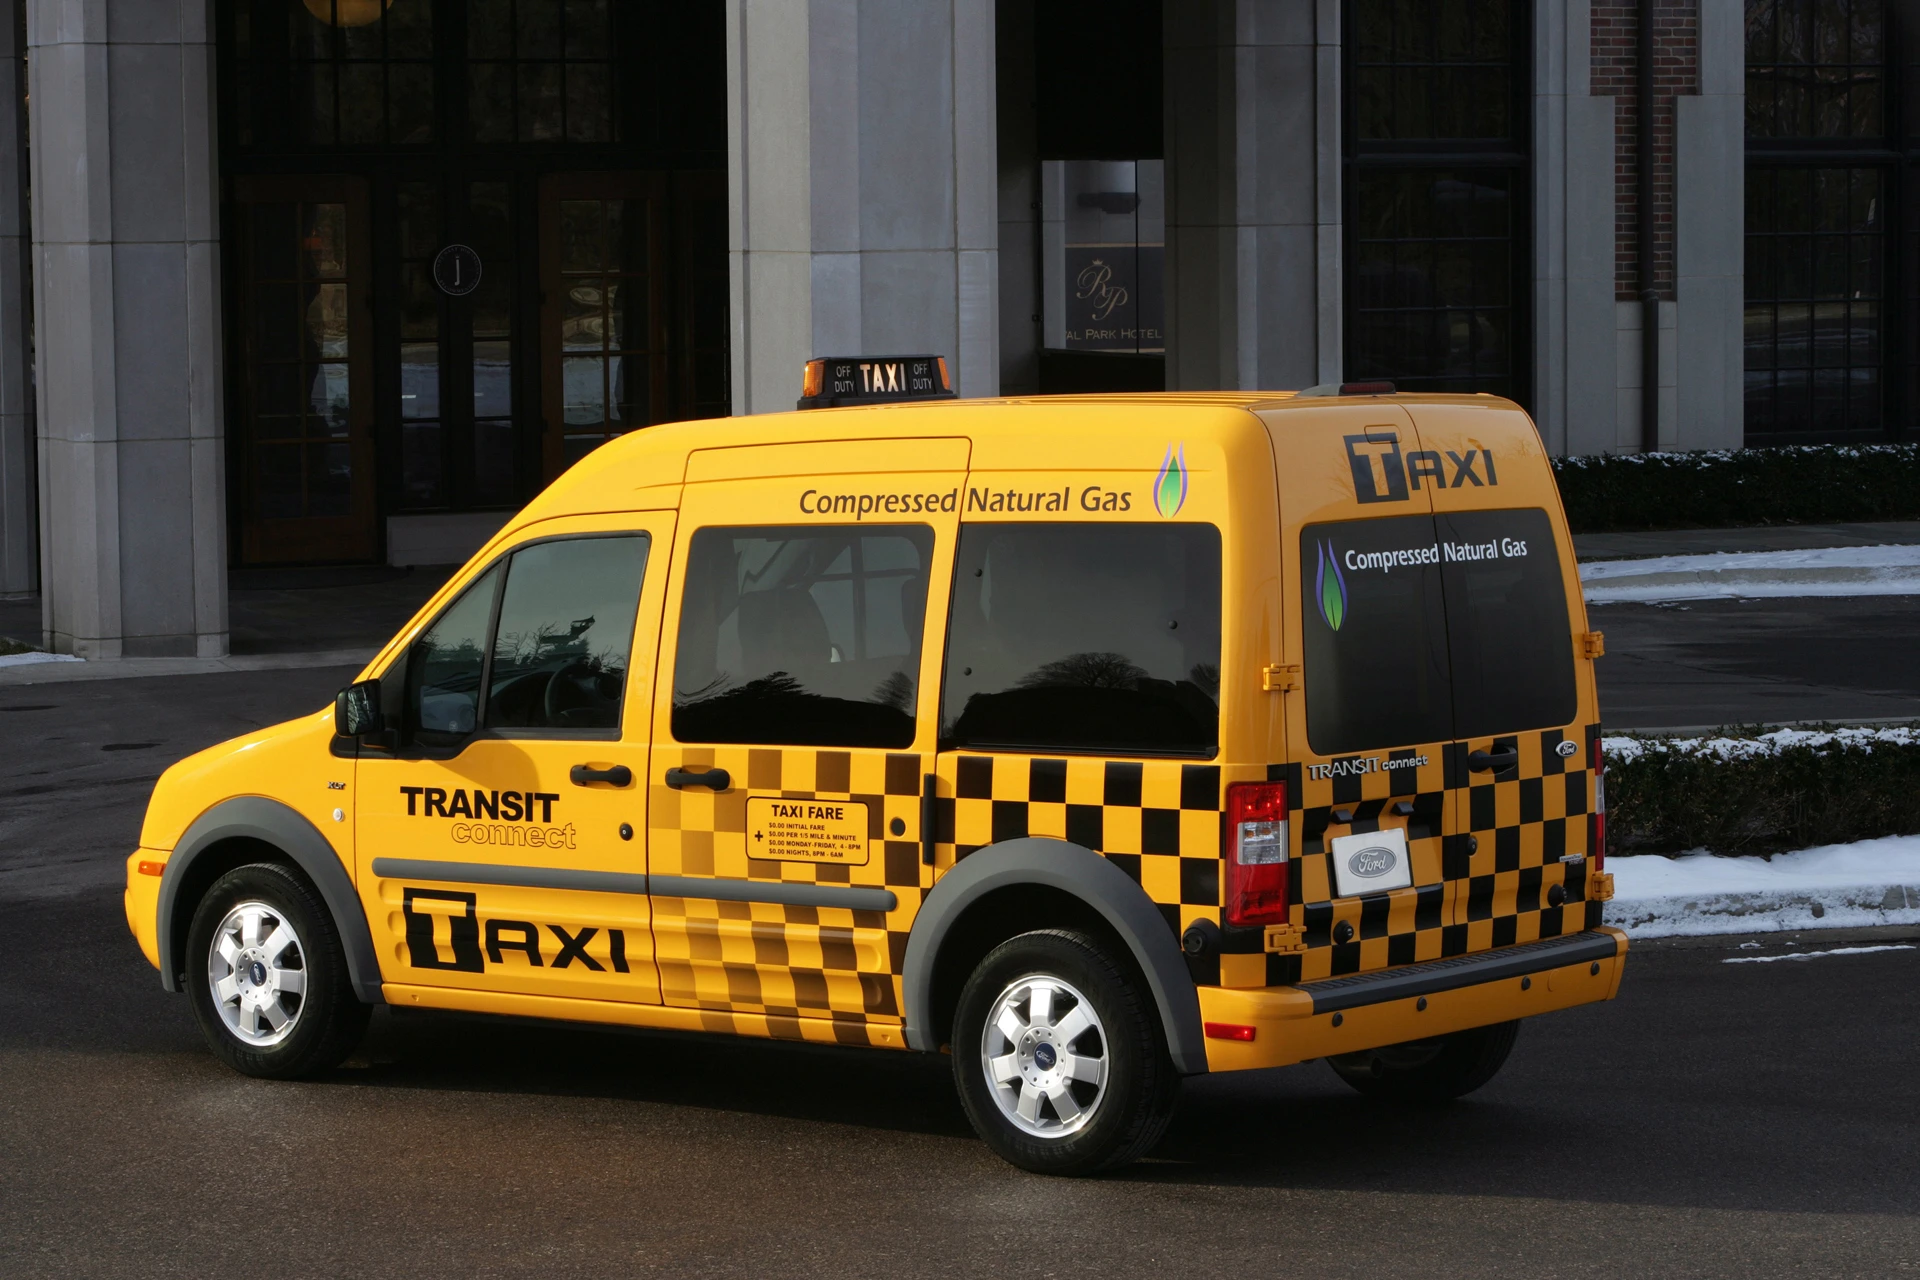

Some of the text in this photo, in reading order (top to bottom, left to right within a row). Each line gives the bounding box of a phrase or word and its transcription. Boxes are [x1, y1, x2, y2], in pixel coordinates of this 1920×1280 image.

[1065, 330, 1082, 340] AL
[1085, 328, 1116, 340] PARK
[836, 365, 851, 378] OFF
[859, 363, 906, 393] TAXI
[913, 363, 928, 375] OFF
[834, 380, 855, 393] DUTY
[912, 377, 933, 390] DUTY
[1343, 432, 1498, 504] TAXI
[800, 485, 1132, 521] Compressed Natural Gas
[1345, 537, 1528, 573] Compressed Natural Gas
[1308, 755, 1429, 781] TRANSIT connect
[400, 786, 560, 823] TRANSIT
[771, 804, 844, 820] TAXI FARE
[451, 822, 576, 850] connect
[832, 834, 857, 842] MINUTE
[786, 849, 811, 857] NIGHTS,
[1357, 851, 1388, 873] Ford
[402, 886, 631, 974] TAXI
